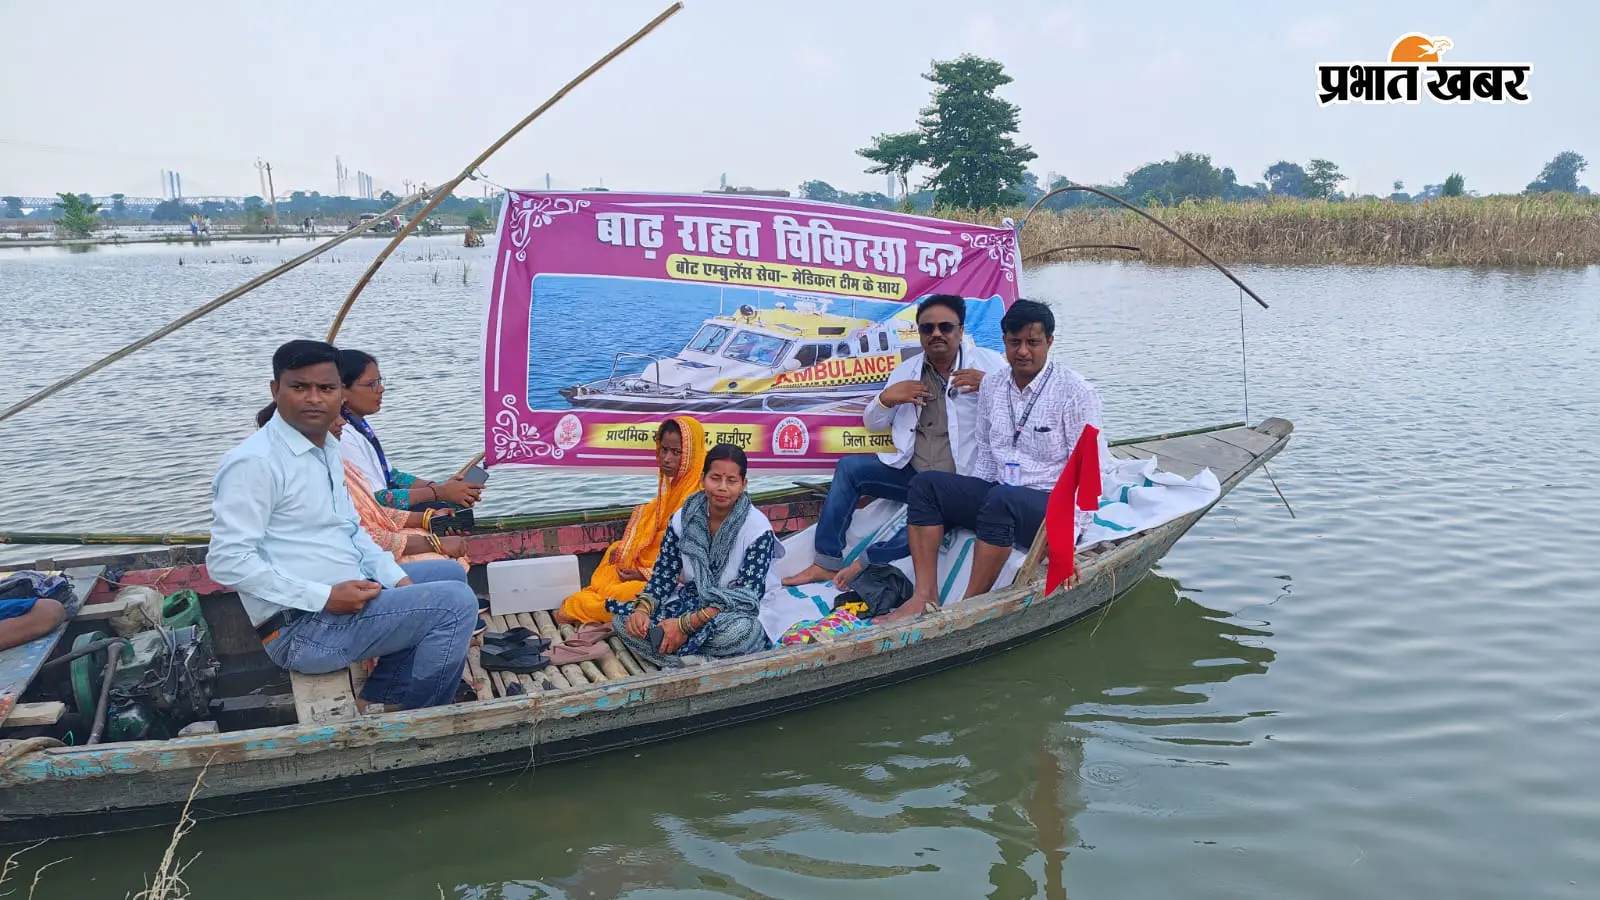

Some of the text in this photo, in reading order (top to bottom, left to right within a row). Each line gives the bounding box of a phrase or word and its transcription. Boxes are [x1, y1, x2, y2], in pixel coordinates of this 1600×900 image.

[595, 212, 964, 278] बाढ़ राहत चिकित्सा दल
[675, 258, 901, 295] बोट एम्बुलेंस सेवा- मेडिकल टीम के साथ
[775, 355, 897, 385] AMBULANCE
[606, 426, 649, 442] प्राथमिक
[716, 427, 752, 449] हाजीपुर
[843, 430, 866, 447] जिला
